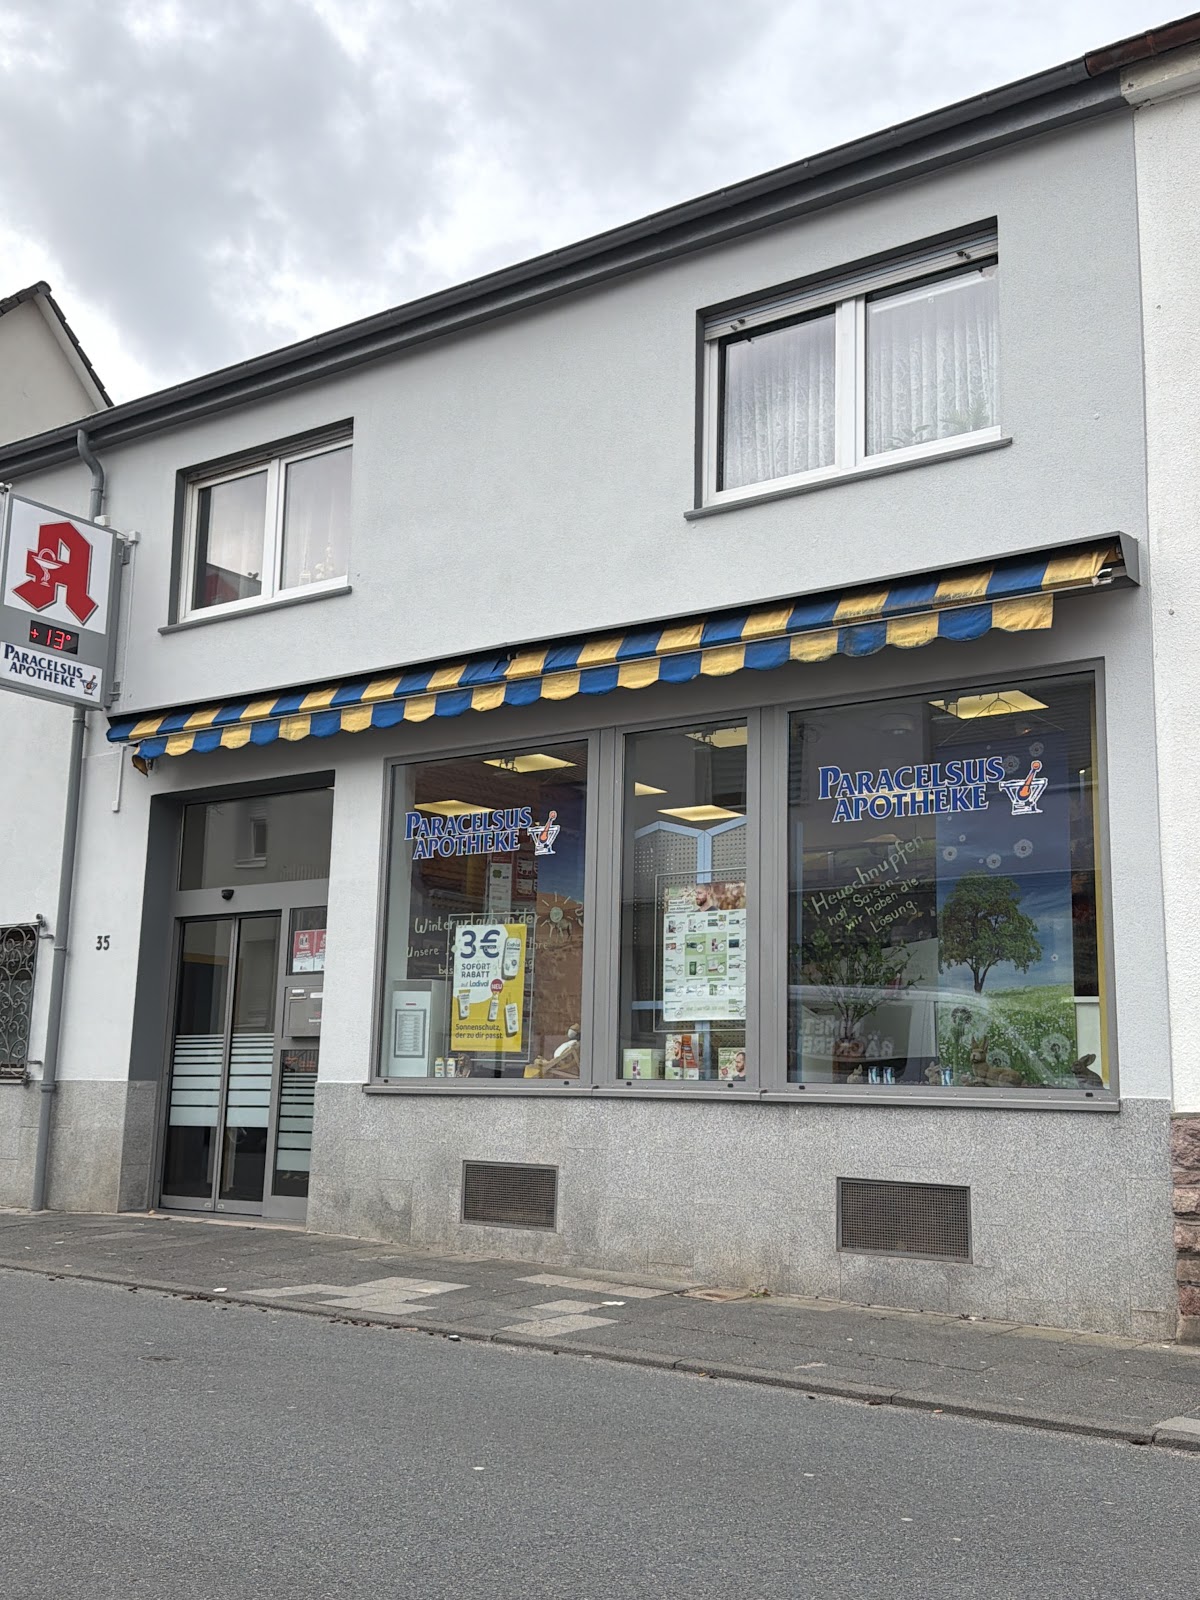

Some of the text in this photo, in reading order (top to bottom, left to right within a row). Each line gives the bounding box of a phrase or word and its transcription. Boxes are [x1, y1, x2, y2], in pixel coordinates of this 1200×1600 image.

[4, 643, 83, 679] PARACELSUS
[9, 661, 76, 688] APOTHEKE
[818, 757, 1005, 799] PARACELSUS
[832, 785, 990, 823] APOTHEKE
[404, 807, 533, 840] PARACELSUS
[412, 829, 521, 860] APOTHEKE
[811, 835, 924, 914] Heuschnupfen
[865, 892, 898, 916] haben
[900, 877, 919, 893] die
[95, 934, 111, 951] 35
